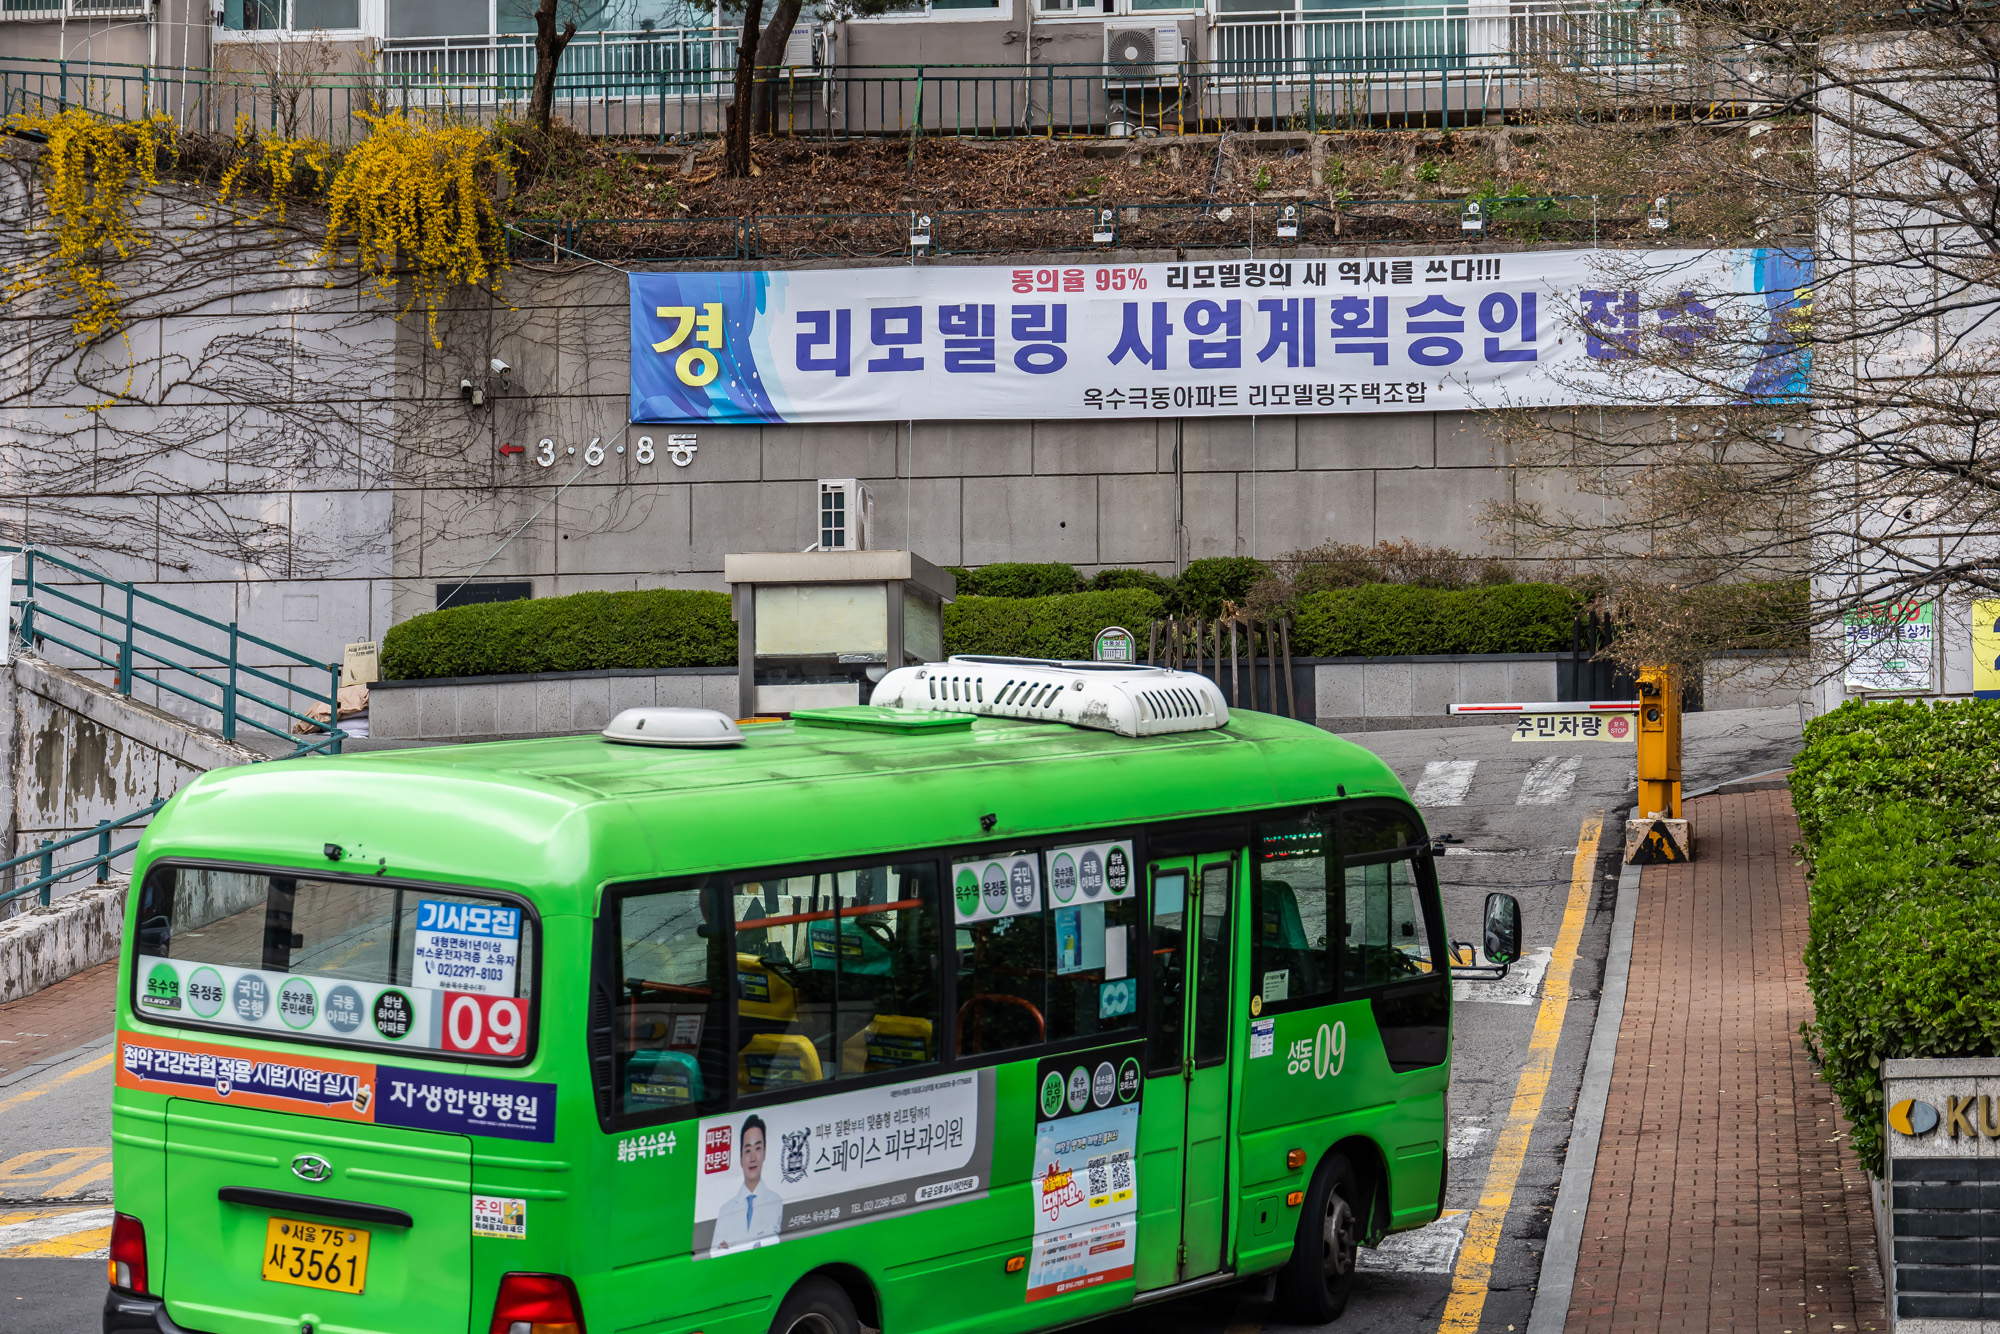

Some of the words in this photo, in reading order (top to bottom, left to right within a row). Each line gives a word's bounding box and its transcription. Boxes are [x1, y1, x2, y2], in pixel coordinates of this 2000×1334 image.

[1012, 269, 1085, 293] 동의율
[1096, 267, 1148, 291] 95%
[1166, 262, 1292, 290] 리모델링의
[1302, 259, 1327, 286] 새
[1337, 258, 1414, 285] 역사를
[1425, 257, 1500, 283] 쓰다!!!
[652, 306, 722, 387] 경
[796, 303, 1068, 377] 리모델링
[1107, 292, 1538, 370] 사업계획승인
[1579, 289, 1716, 360] 접수
[1083, 385, 1239, 411] 옥수극동아파트
[1248, 382, 1427, 408] 리모델링주택조합
[1846, 624, 1931, 640] 극동아트상가
[1516, 716, 1602, 738] 주민차량
[1083, 860, 1097, 874] 극동
[1110, 853, 1123, 865] 한남
[1013, 866, 1031, 883] 국민
[1054, 877, 1076, 889] 주민센터
[1081, 873, 1102, 889] 아파트
[1109, 876, 1127, 889] 아파트
[956, 884, 980, 901] 옥수역
[983, 880, 1007, 897] 옥정중
[1015, 883, 1032, 902] 은행
[421, 903, 516, 936] 기사모집
[431, 936, 502, 953] 대형면허1년이상
[416, 947, 481, 964] 버스운전자격증
[486, 954, 515, 966] 소유자
[437, 963, 503, 981] 02)2297-8103
[147, 978, 179, 996] 옥수역
[189, 983, 223, 1002] 옥정중
[239, 979, 264, 999] 국민
[143, 996, 170, 1006] EURO
[283, 990, 313, 1005] 옥수2동
[334, 995, 355, 1010] 극동
[383, 995, 403, 1009] 한남
[238, 1001, 264, 1019] 은행
[280, 1001, 315, 1016] 주민센터
[378, 1008, 407, 1022] 하이츠
[326, 1010, 360, 1025] 아파트
[449, 995, 522, 1053] 09
[378, 1021, 407, 1034] 아파트
[1287, 1039, 1313, 1075] 성동
[1315, 1021, 1346, 1080] 09
[124, 1046, 152, 1070] 첩약
[154, 1049, 217, 1079] 건강보험
[218, 1059, 251, 1084] 적용
[253, 1063, 321, 1093] 시범사업
[322, 1074, 359, 1099] 실시
[1046, 1081, 1061, 1096] 삼성
[1073, 1076, 1085, 1088] 옥수
[390, 1081, 538, 1123] 자생한방병원
[1045, 1094, 1061, 1109] APT
[815, 1123, 832, 1140] 피부
[834, 1118, 865, 1137] 질환부터
[867, 1110, 891, 1131] 맞춤형
[893, 1106, 931, 1126] 리프팅까지
[617, 1130, 676, 1162] 화송옥수운수
[706, 1129, 731, 1148] 피부과
[813, 1136, 881, 1173] 스페이스
[885, 1116, 964, 1162] 피부과의원
[704, 1149, 731, 1172] 전문의
[475, 1199, 502, 1216] 주의
[812, 1208, 830, 1222] 옥수점
[292, 1225, 316, 1243] 서울
[321, 1229, 344, 1247] 75
